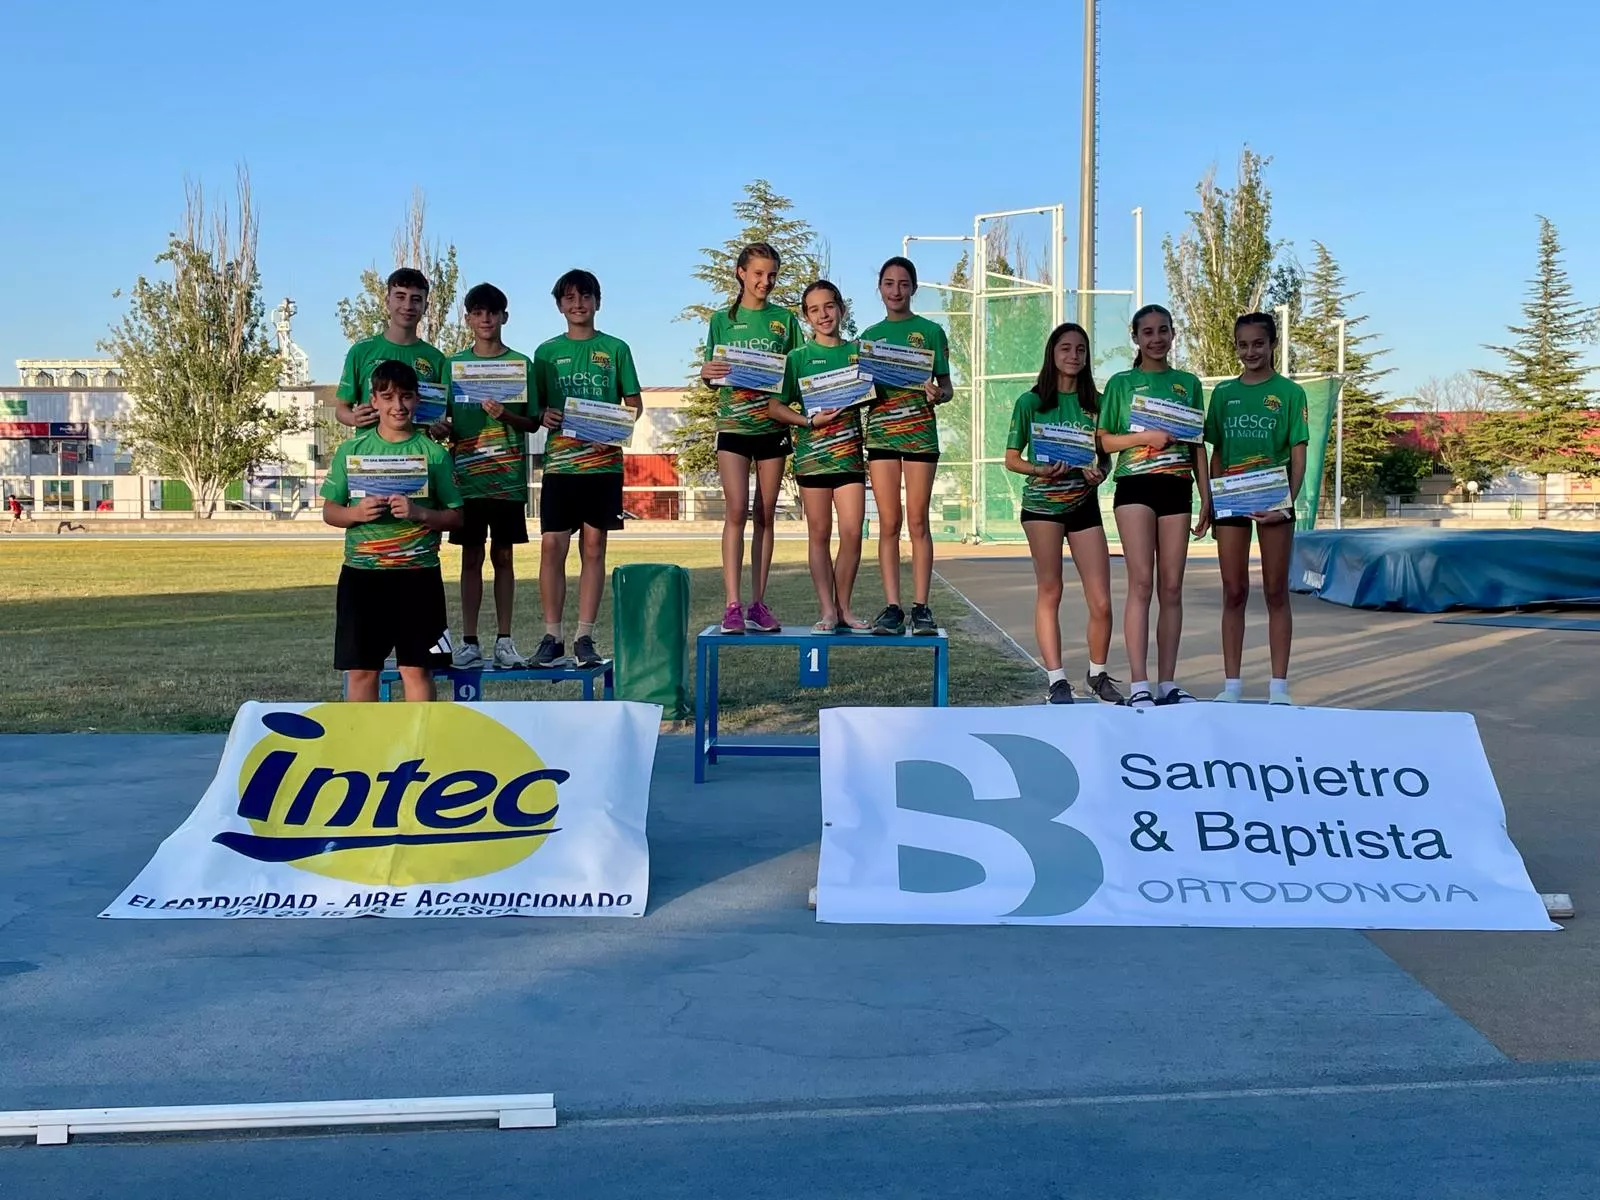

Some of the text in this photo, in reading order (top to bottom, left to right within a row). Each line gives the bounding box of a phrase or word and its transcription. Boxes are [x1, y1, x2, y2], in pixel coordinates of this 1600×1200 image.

[806, 648, 820, 672] 1
[237, 712, 571, 829] intec
[1120, 753, 1430, 802] Sampietro
[1130, 811, 1453, 866] & Baptista
[344, 891, 407, 908] AIRE
[416, 889, 633, 908] ACONDICIONADO
[1138, 878, 1479, 904] ORTODONCIA
